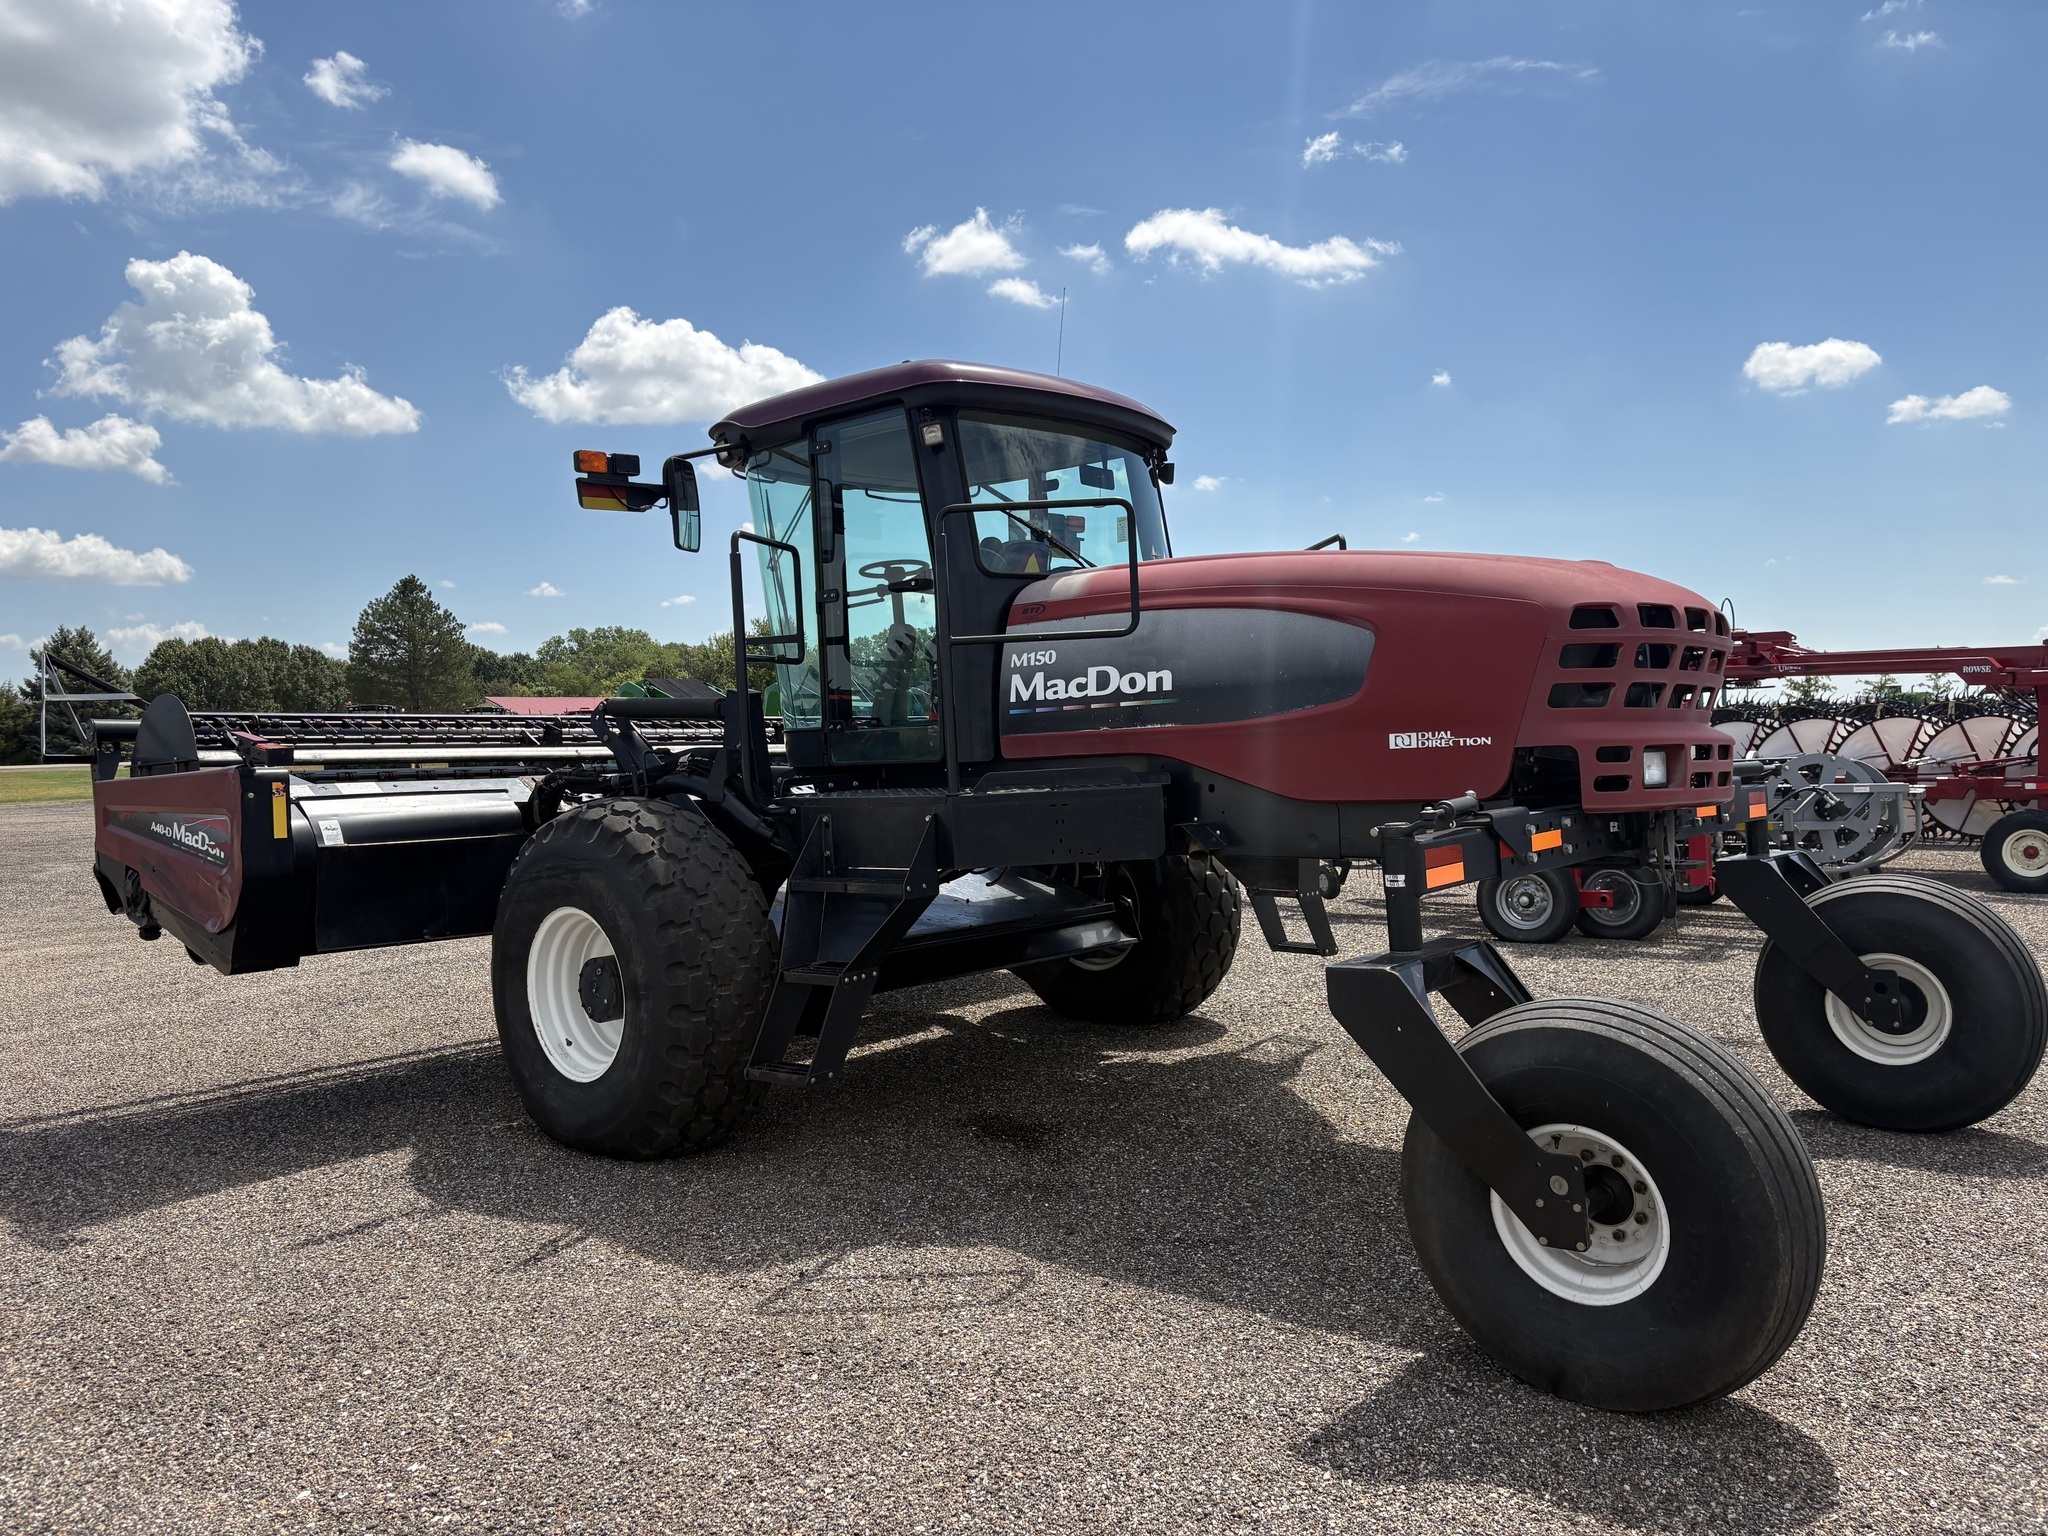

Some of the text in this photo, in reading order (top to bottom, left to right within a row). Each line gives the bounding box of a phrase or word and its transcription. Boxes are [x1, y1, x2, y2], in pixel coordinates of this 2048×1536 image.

[1010, 650, 1057, 668] M150
[1962, 665, 1992, 673] ROWSE
[1009, 665, 1173, 703] MacDon
[1418, 730, 1455, 740] DUAL
[1418, 736, 1492, 749] DIRECTION
[150, 821, 173, 838] A40-D
